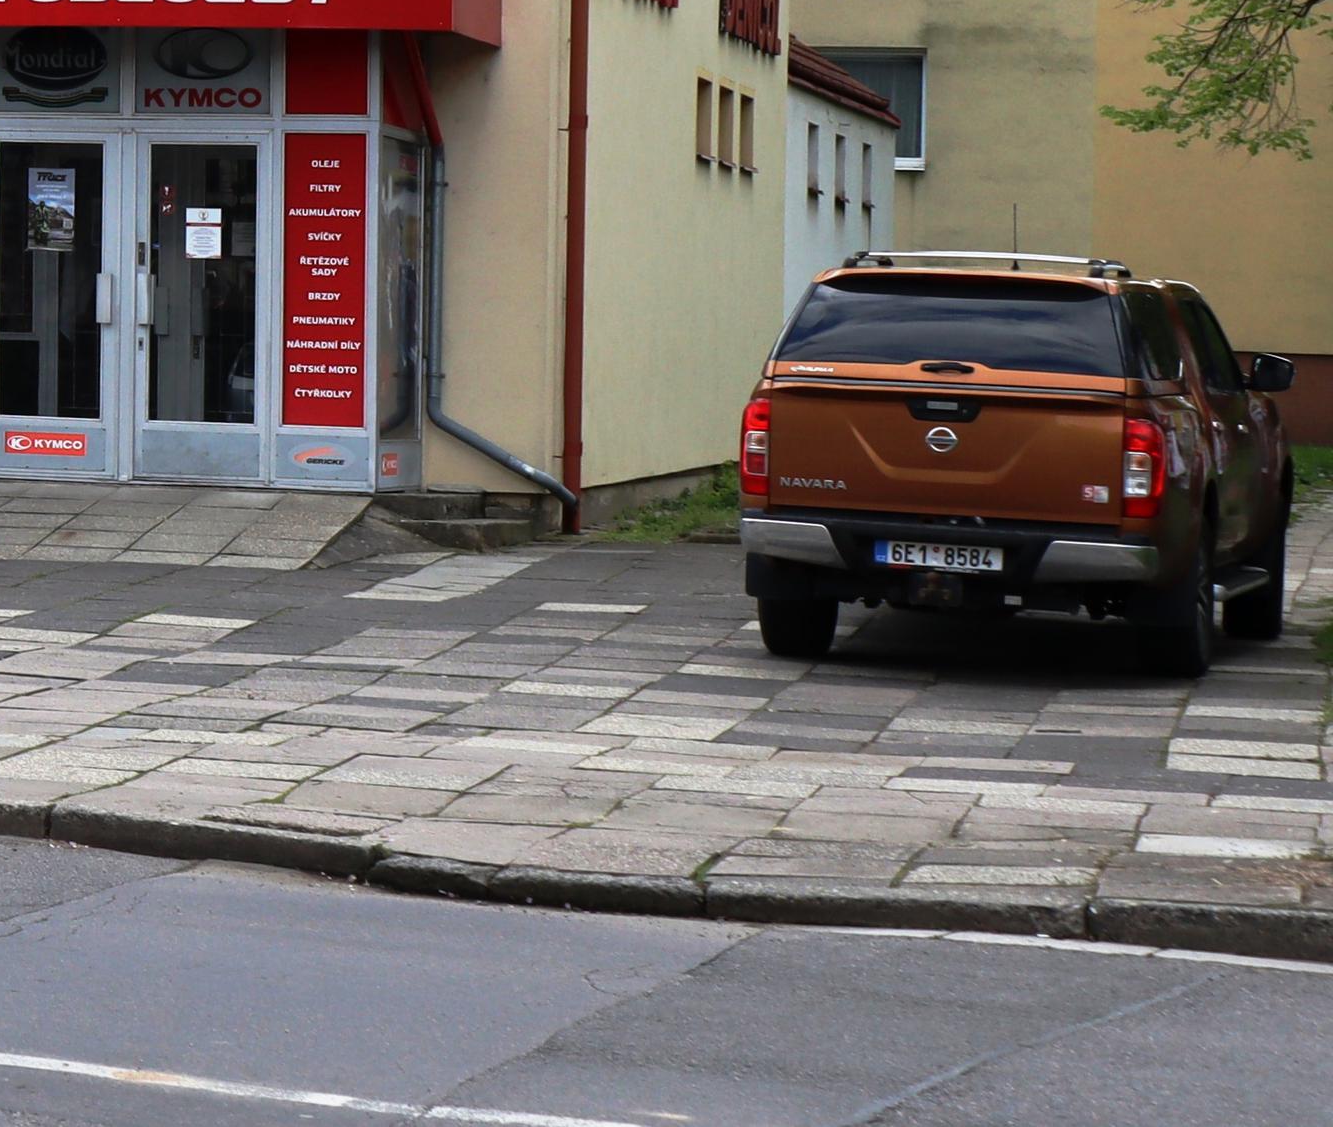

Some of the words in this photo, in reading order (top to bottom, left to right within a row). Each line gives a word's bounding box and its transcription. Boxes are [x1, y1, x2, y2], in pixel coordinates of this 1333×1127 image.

[5, 41, 108, 80] Mondial
[144, 88, 262, 108] KYMCO
[311, 160, 340, 168] OLEJE
[309, 184, 341, 192] FILTRY
[289, 208, 361, 217] AKUMULÁTORY
[308, 231, 342, 241] SVÍČKY
[300, 255, 350, 266] ŘETĚZOVÉ
[311, 268, 337, 276] SADY
[308, 292, 341, 301] BRZDY
[293, 316, 355, 325] PNEUMATIKY
[286, 339, 338, 349] NÁHRADNÍ
[340, 340, 361, 350] DÍLY
[289, 364, 326, 373] DĚTSKÉ
[328, 365, 358, 374] MOTO
[294, 388, 352, 398] ČTYŘKOLKY
[34, 439, 83, 450] KYMCO
[306, 457, 345, 465] GERICKE
[780, 476, 847, 490] NAVARA
[892, 543, 928, 565] 6E1
[944, 547, 993, 569] 8584
